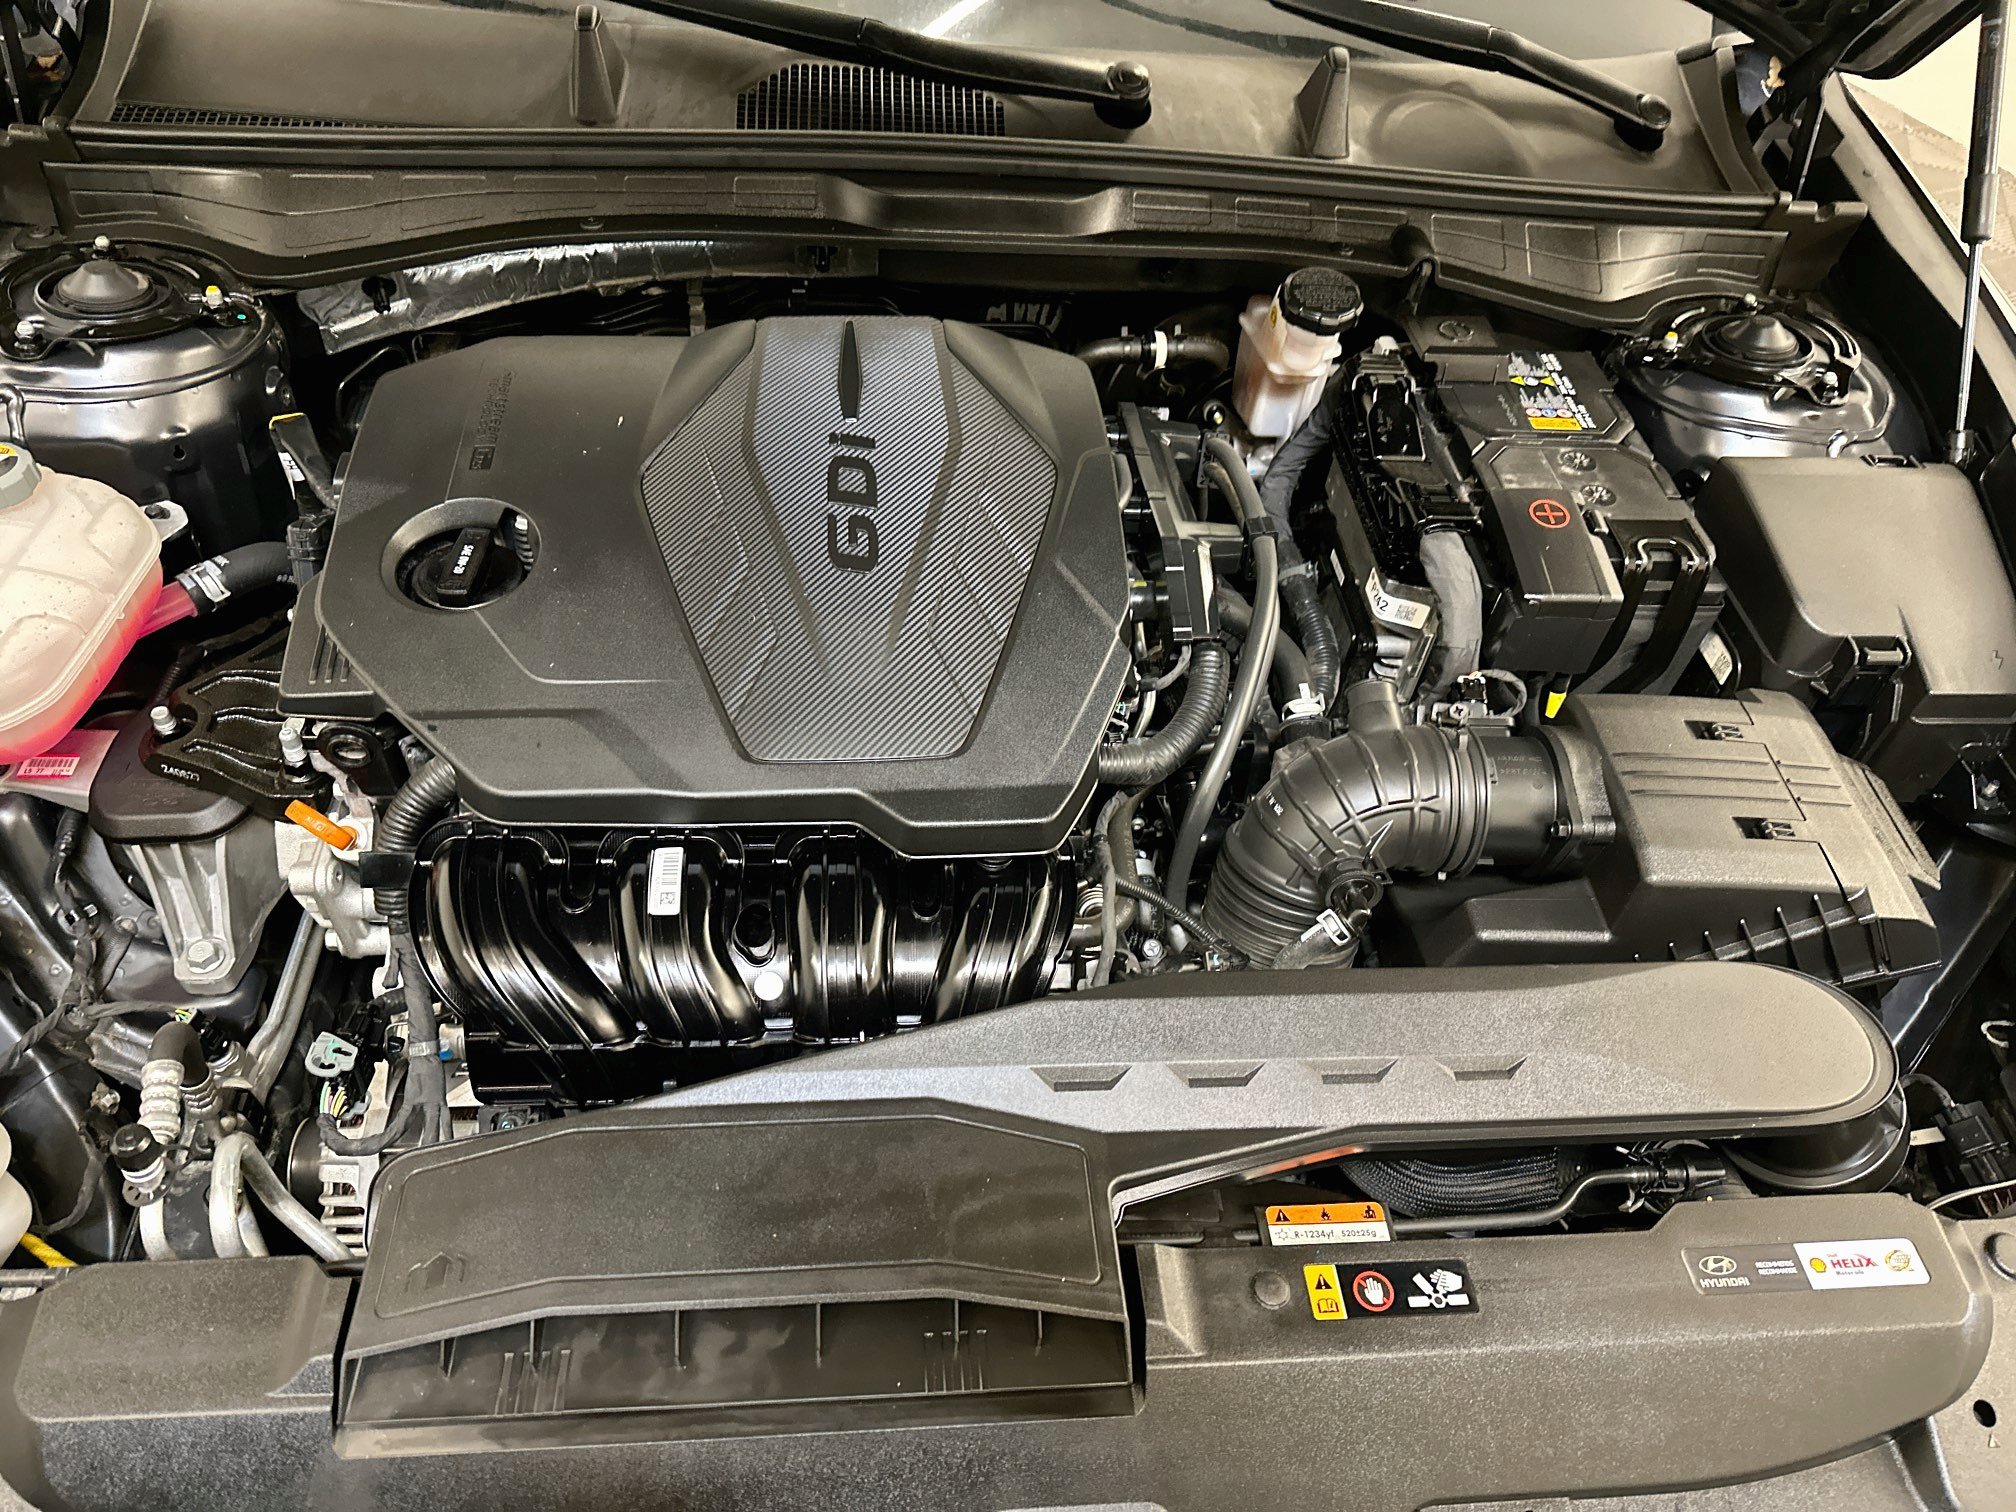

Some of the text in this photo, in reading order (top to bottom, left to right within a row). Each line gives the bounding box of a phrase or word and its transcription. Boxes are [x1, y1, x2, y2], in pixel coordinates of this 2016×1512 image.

[1294, 1229, 1377, 1240] R-1234yf 520±25g
[1829, 1256, 1878, 1269] HELIX
[1699, 1276, 1751, 1288] HYUNDAI
